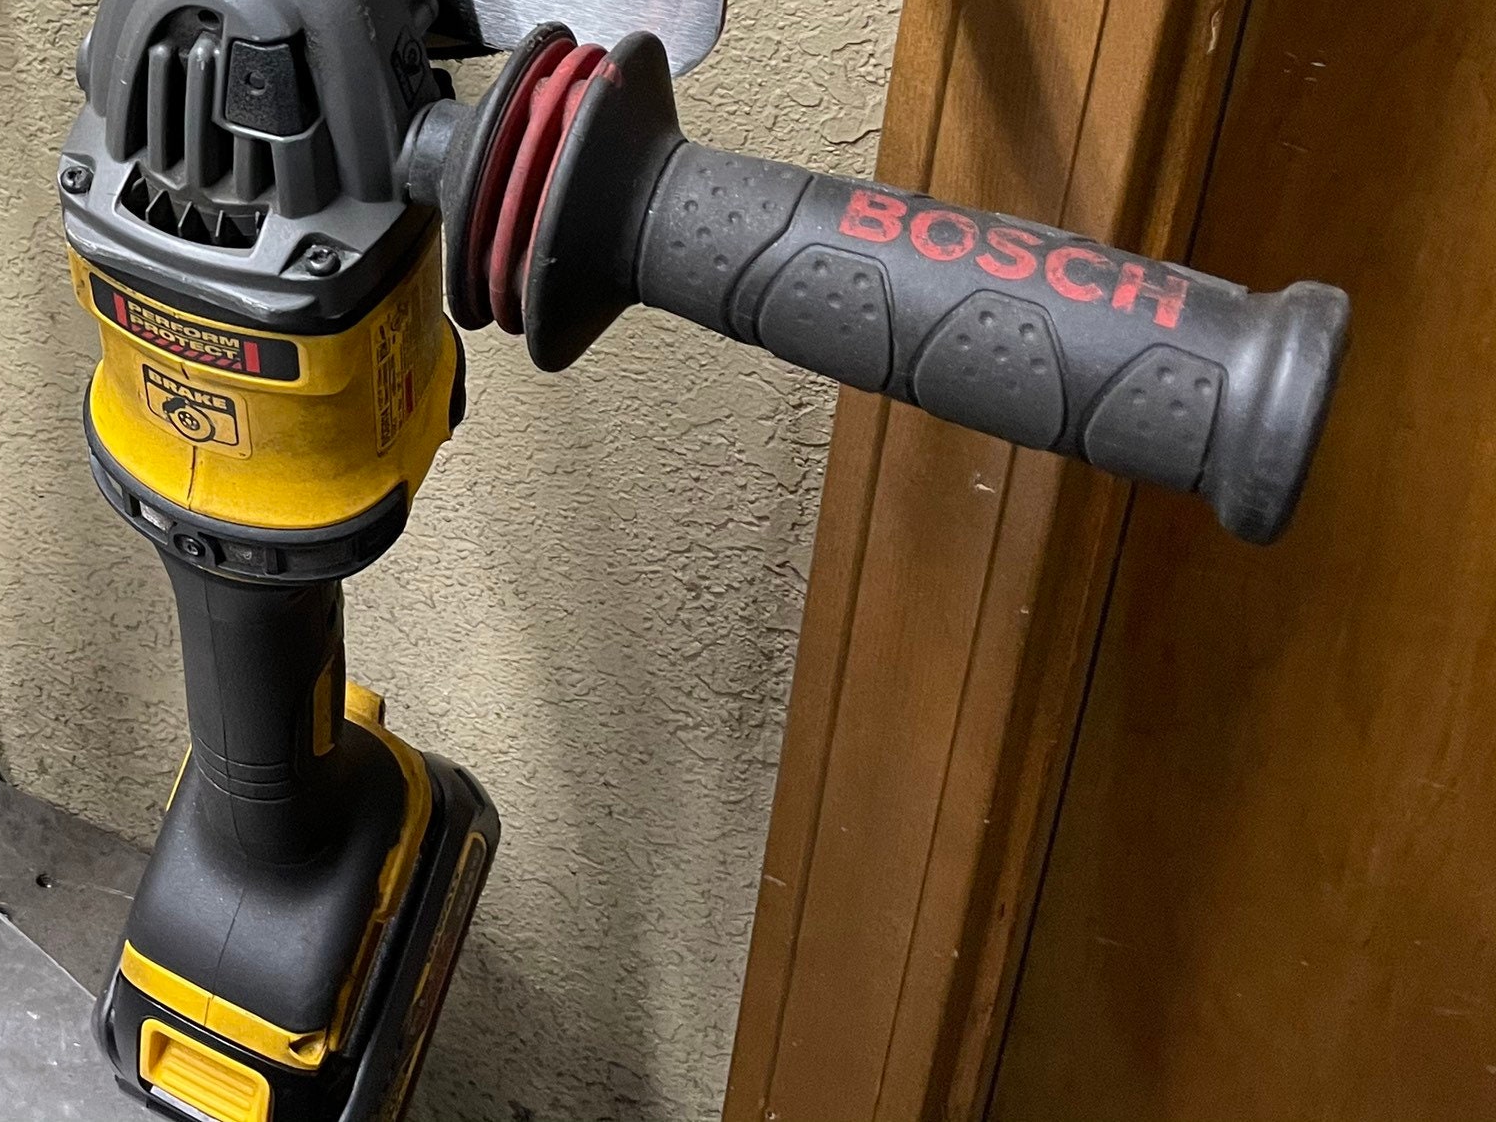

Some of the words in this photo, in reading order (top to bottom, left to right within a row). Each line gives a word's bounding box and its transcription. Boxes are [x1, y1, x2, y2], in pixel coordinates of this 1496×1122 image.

[838, 189, 1190, 329] BOSCH
[127, 301, 241, 349] PERFORM
[128, 316, 240, 362] PROTECT
[147, 368, 227, 411] BRAKE
